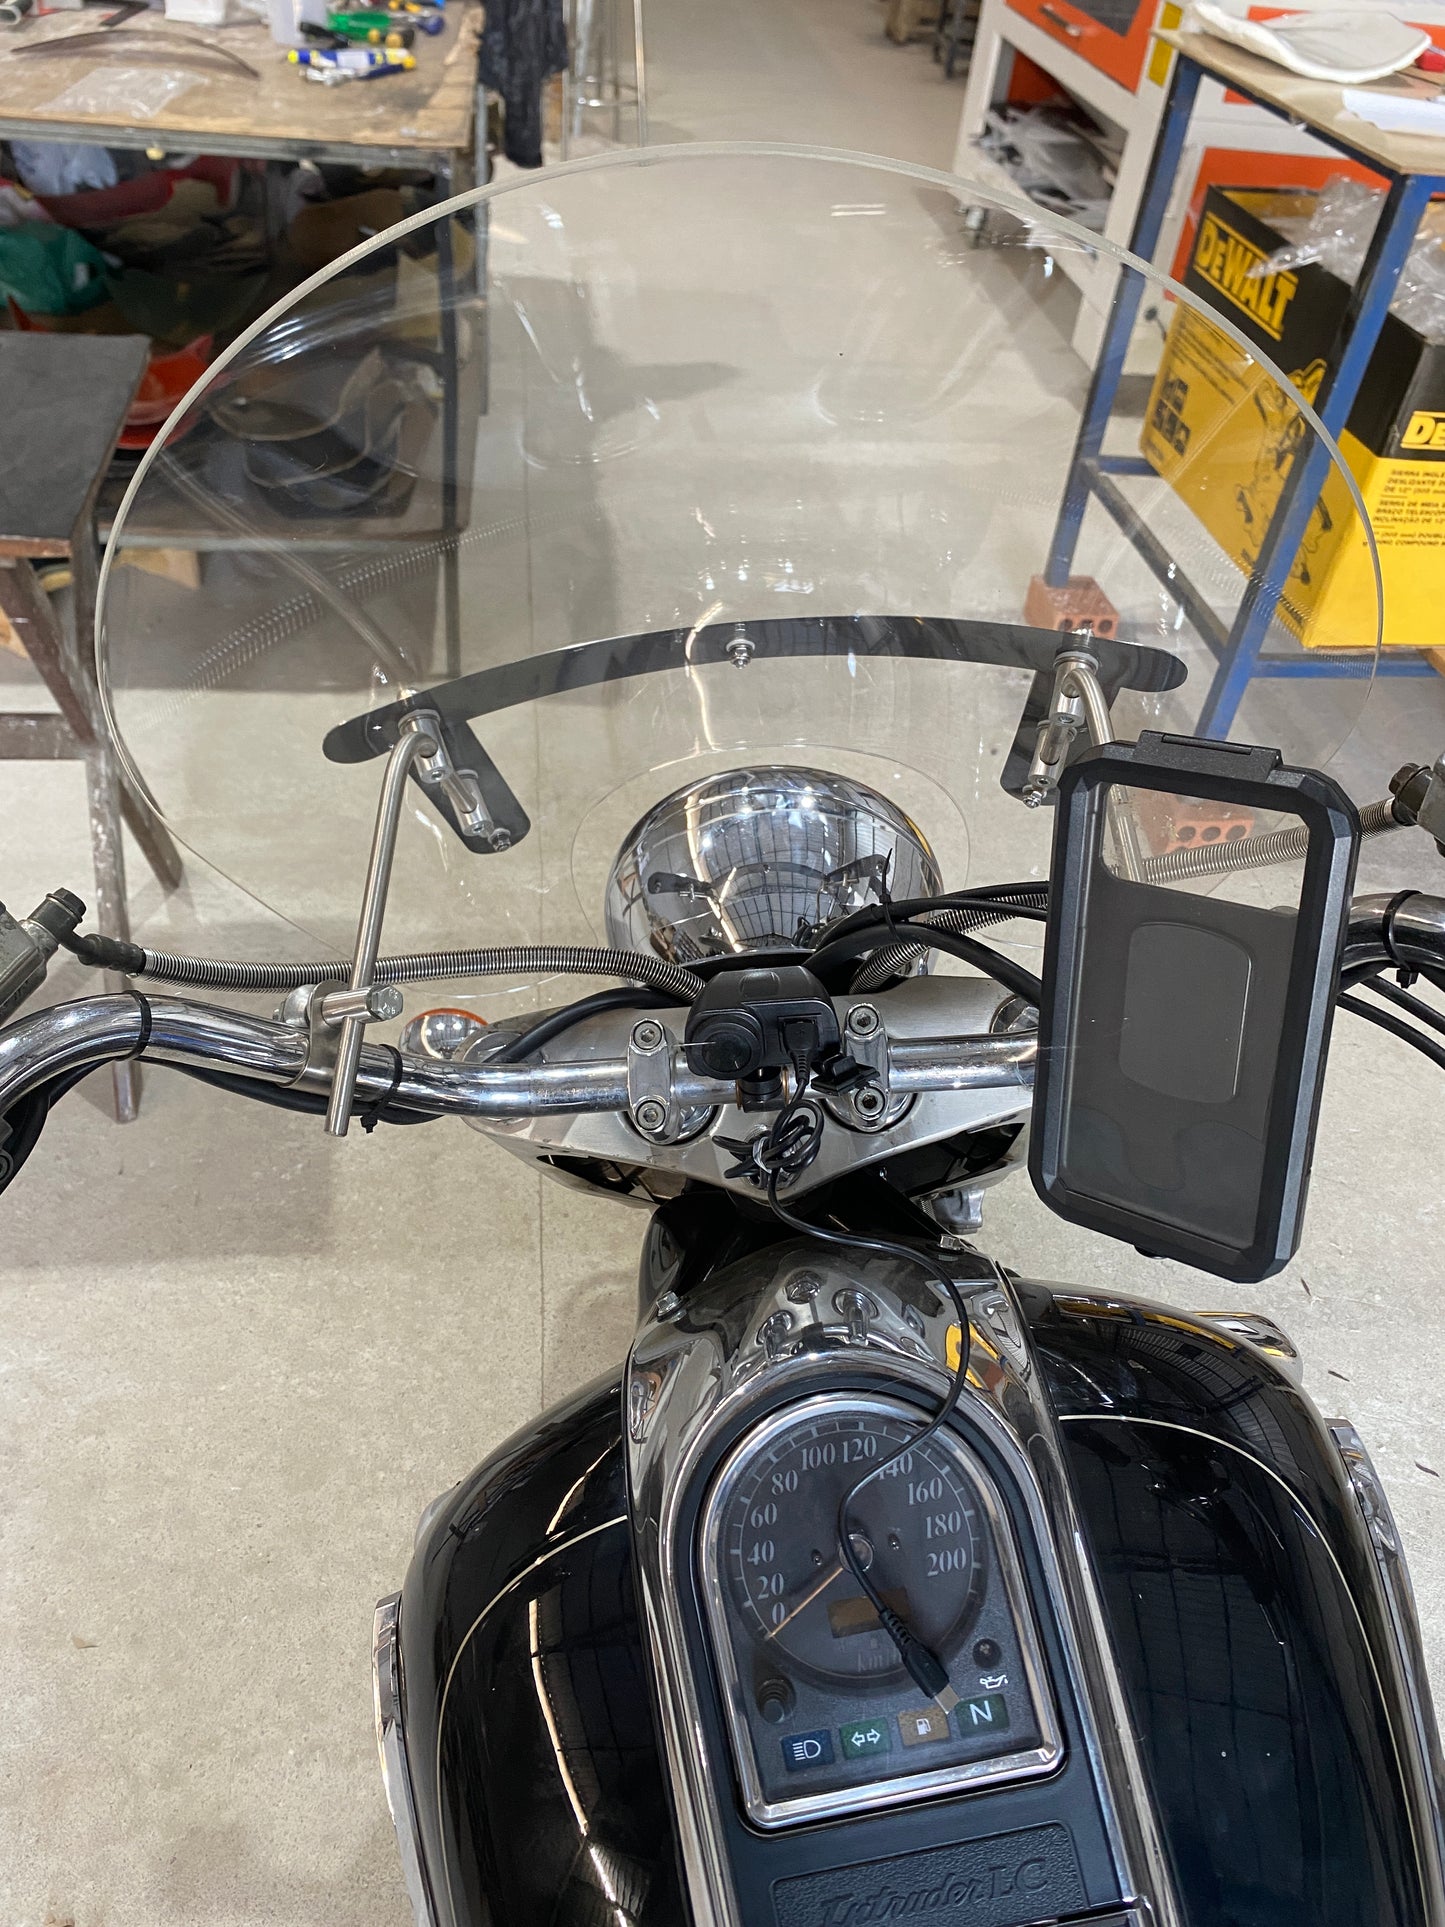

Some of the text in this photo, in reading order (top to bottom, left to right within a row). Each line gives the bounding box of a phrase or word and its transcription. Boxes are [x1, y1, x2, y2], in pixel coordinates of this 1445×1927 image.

[1195, 217, 1297, 332] DEWALT
[802, 1443, 836, 1471] 100
[843, 1435, 877, 1463] 120
[771, 1469, 798, 1496] 80
[908, 1477, 943, 1506] 160
[751, 1502, 778, 1529] 60
[926, 1510, 961, 1539] 180
[747, 1540, 775, 1565] 40
[927, 1547, 967, 1577] 200
[757, 1572, 785, 1600] 20
[771, 1602, 786, 1626] 0
[969, 1700, 994, 1726] N
[988, 1856, 1050, 1903] LC
